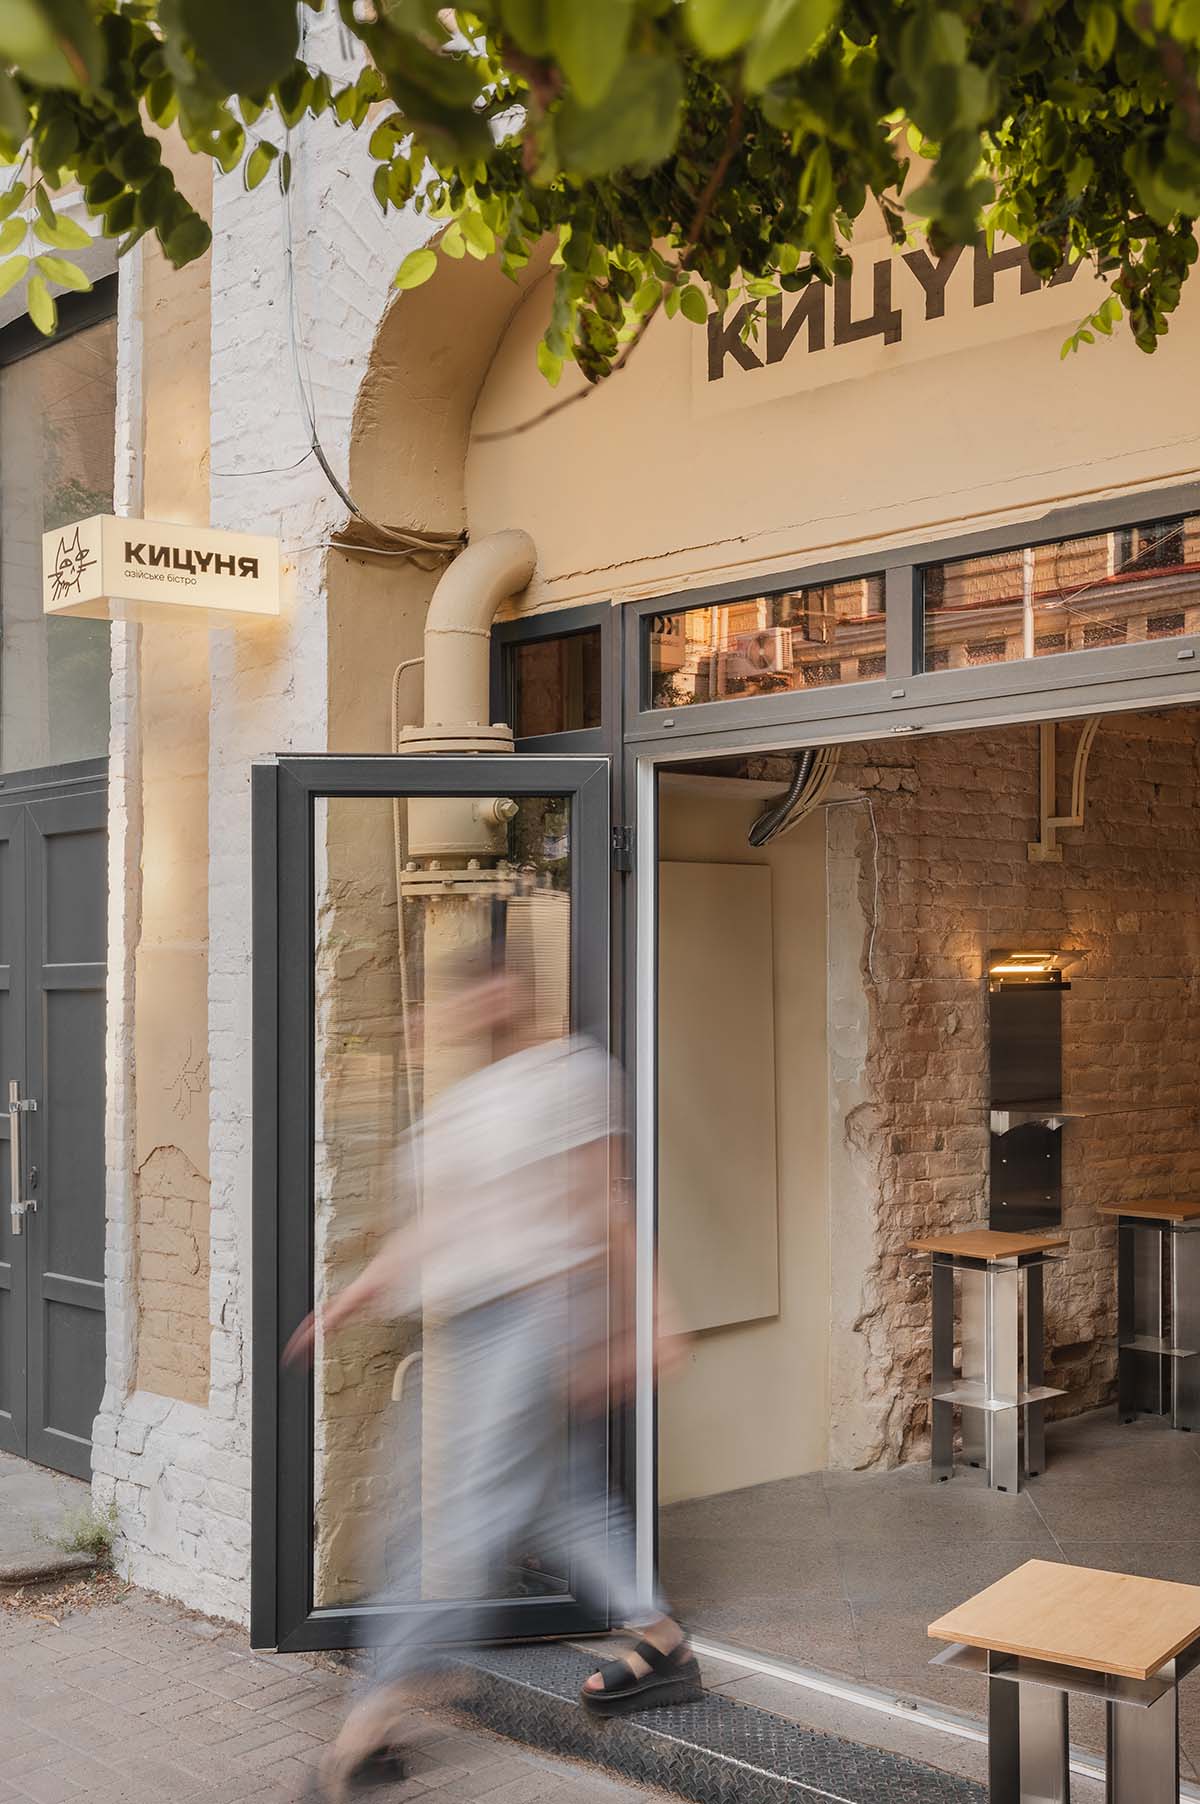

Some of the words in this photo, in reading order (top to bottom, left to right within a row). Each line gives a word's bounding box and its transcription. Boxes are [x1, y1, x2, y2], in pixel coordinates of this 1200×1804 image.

[706, 210, 1123, 382] КИЦУН
[124, 569, 165, 582] азійське
[167, 573, 198, 585] бістро
